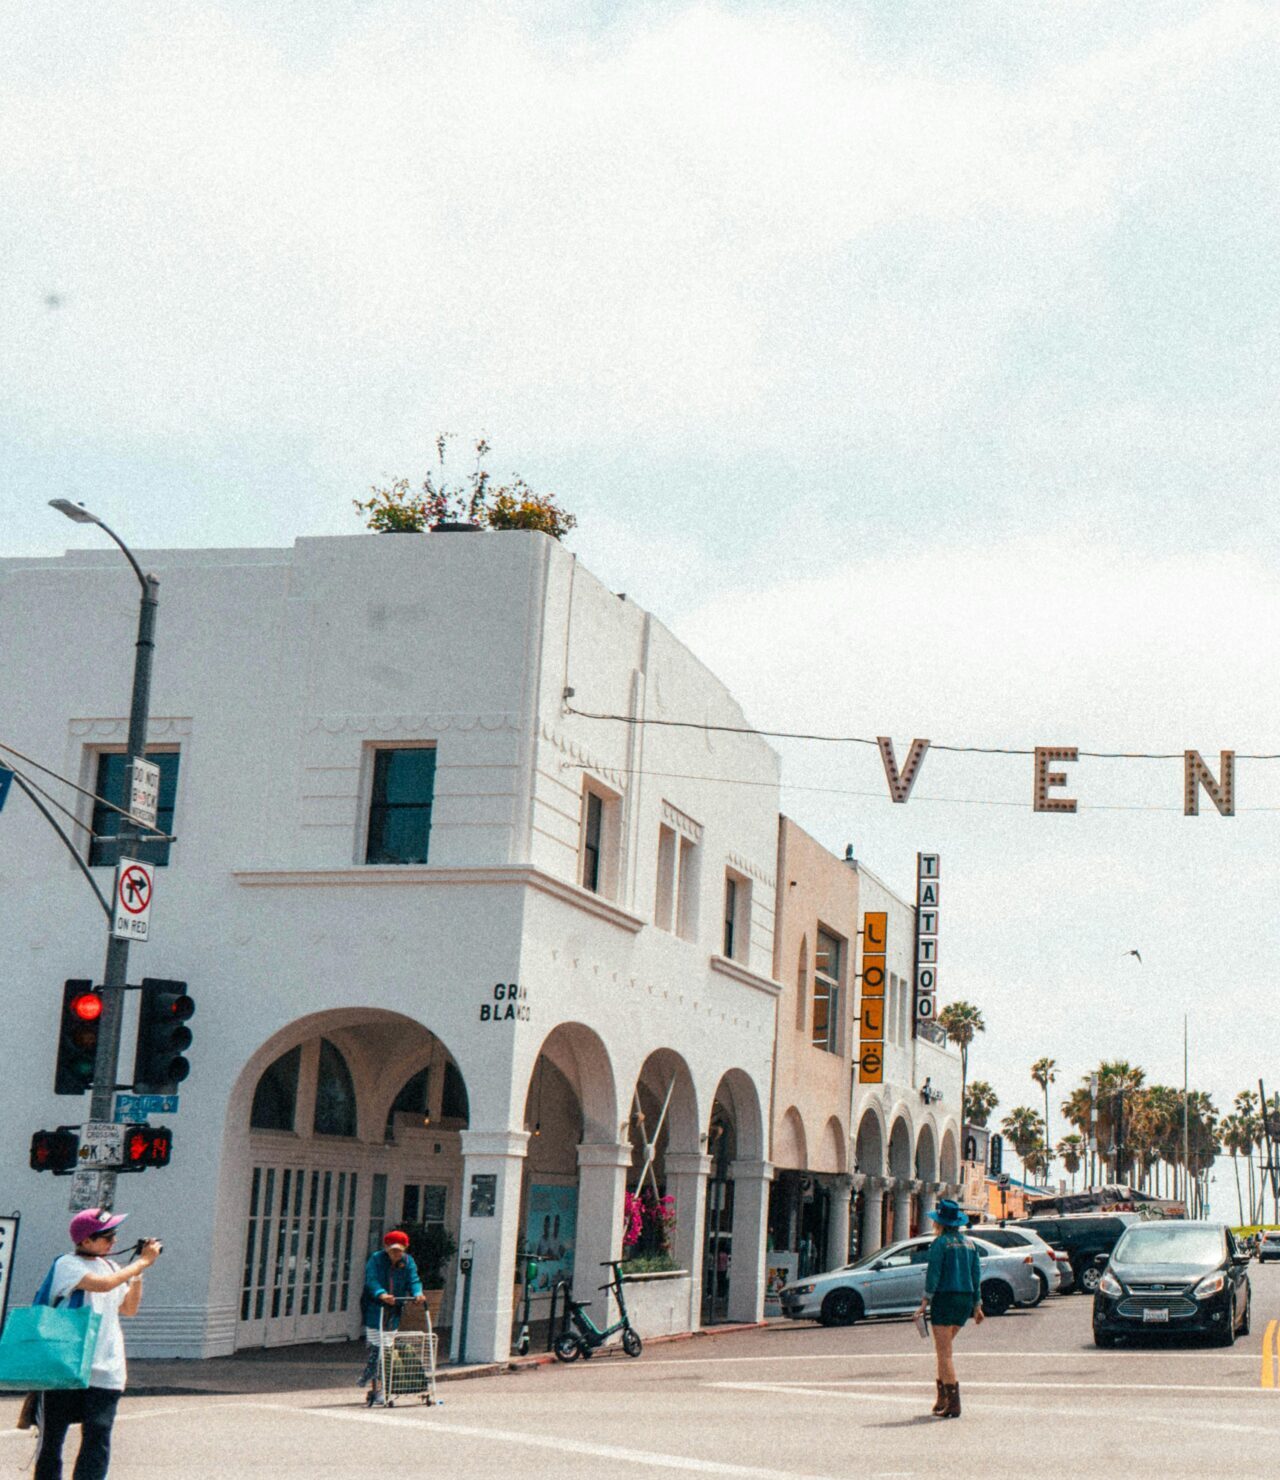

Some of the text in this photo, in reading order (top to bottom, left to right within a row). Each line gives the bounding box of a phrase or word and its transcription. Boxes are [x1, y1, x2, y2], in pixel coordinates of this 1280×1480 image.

[118, 917, 147, 934] ON RED
[919, 856, 936, 1017] TATTOO
